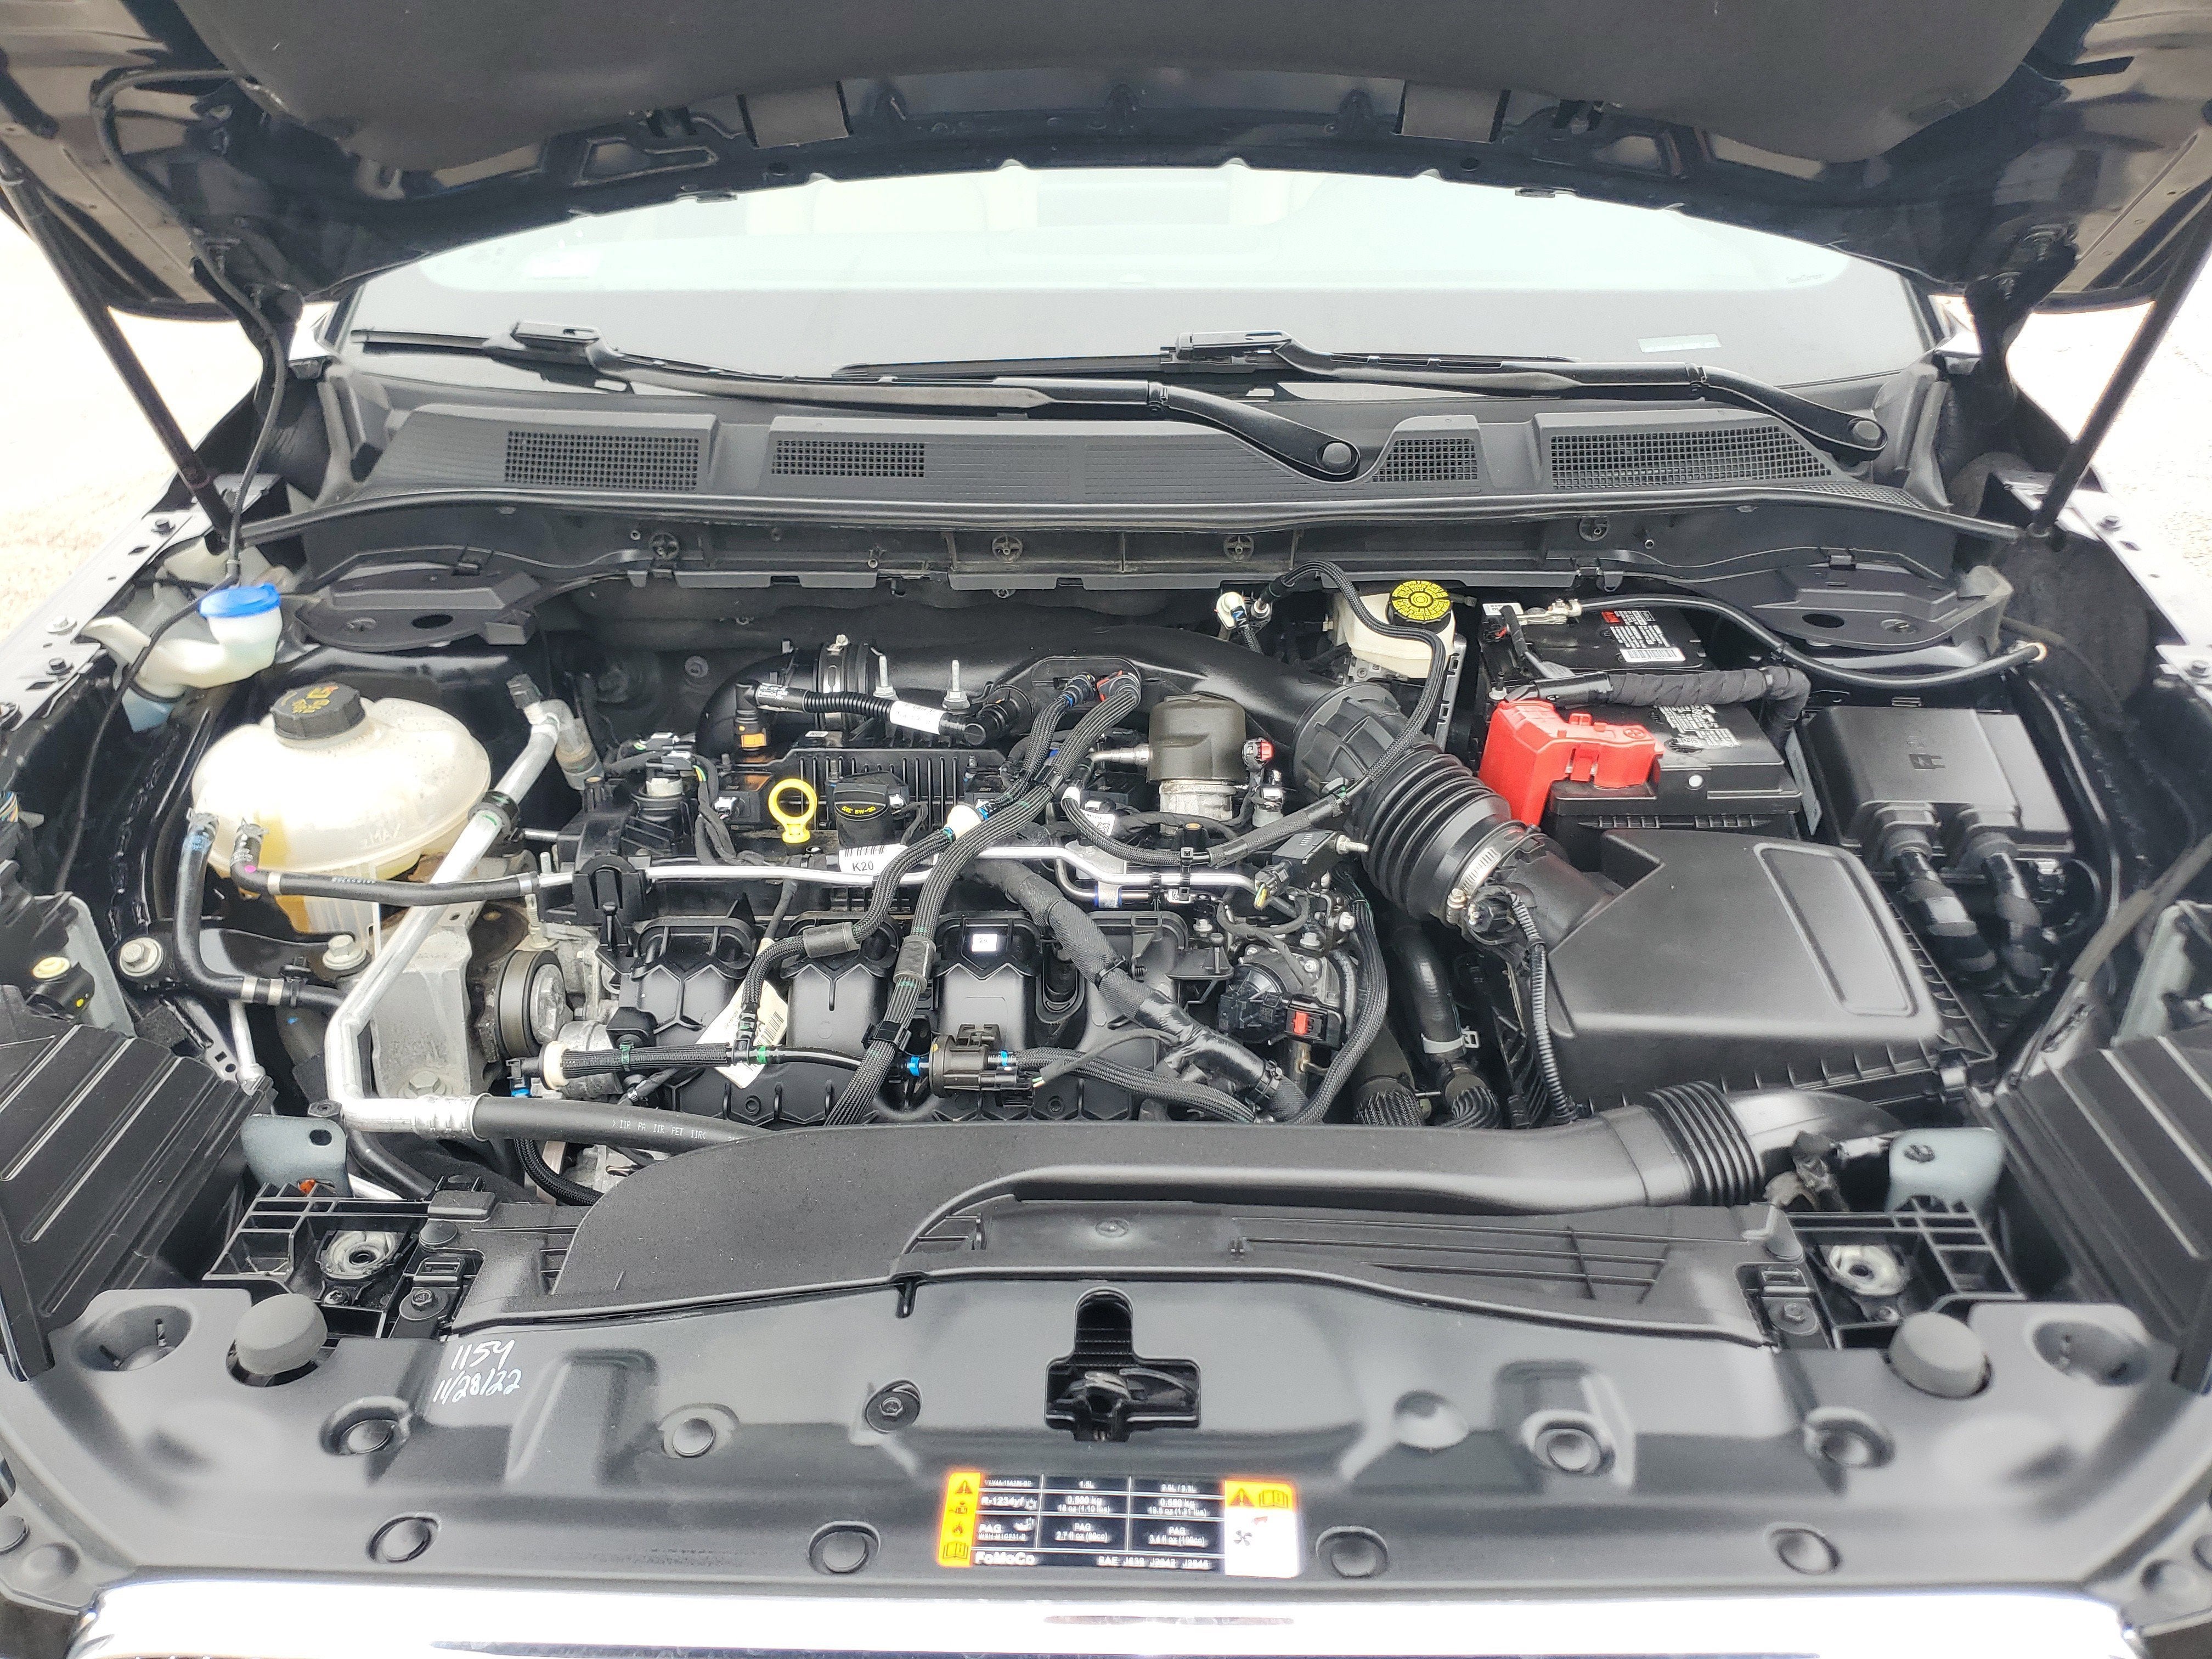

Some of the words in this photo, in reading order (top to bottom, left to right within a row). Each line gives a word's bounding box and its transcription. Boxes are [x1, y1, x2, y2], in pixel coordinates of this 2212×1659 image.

[852, 861, 874, 872] K20
[637, 1121, 646, 1131] PA
[653, 1124, 665, 1133] IIR
[671, 1126, 684, 1136] PET
[433, 1368, 522, 1405] 11/28/22
[979, 1523, 1002, 1533] PAG
[1074, 1522, 1091, 1531] PAG
[1169, 1526, 1186, 1535] PAG
[975, 1551, 1035, 1565] FoMoCo
[1098, 1556, 1119, 1565] SAE
